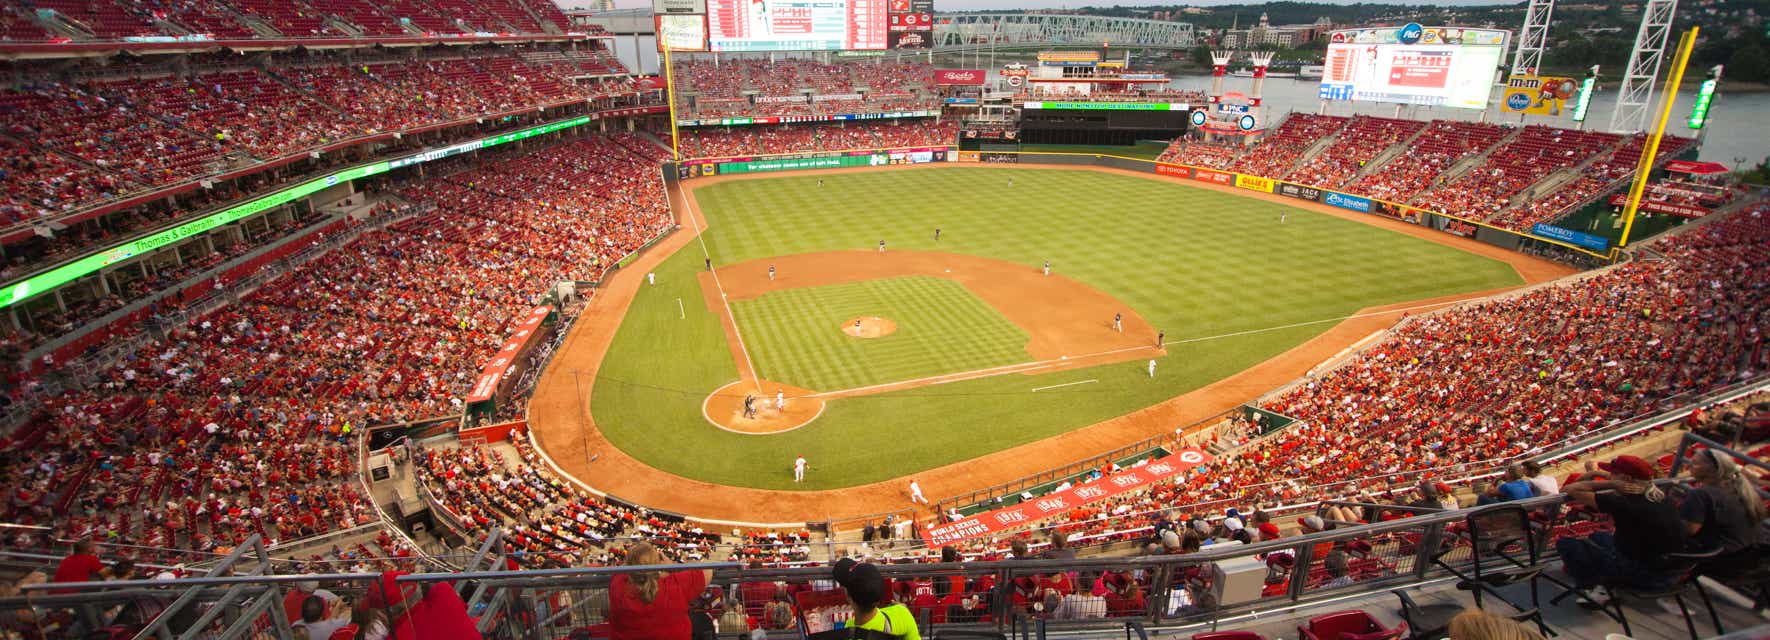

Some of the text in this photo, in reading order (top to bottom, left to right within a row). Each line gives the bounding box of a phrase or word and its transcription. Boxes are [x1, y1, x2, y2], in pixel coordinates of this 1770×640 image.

[1167, 166, 1188, 175] TOYOTA
[135, 217, 215, 252] Thomas & Galbraith
[1537, 223, 1575, 237] POMEROY
[930, 518, 980, 537] WORLD SERIES
[931, 523, 989, 545] CHAMPIONS
